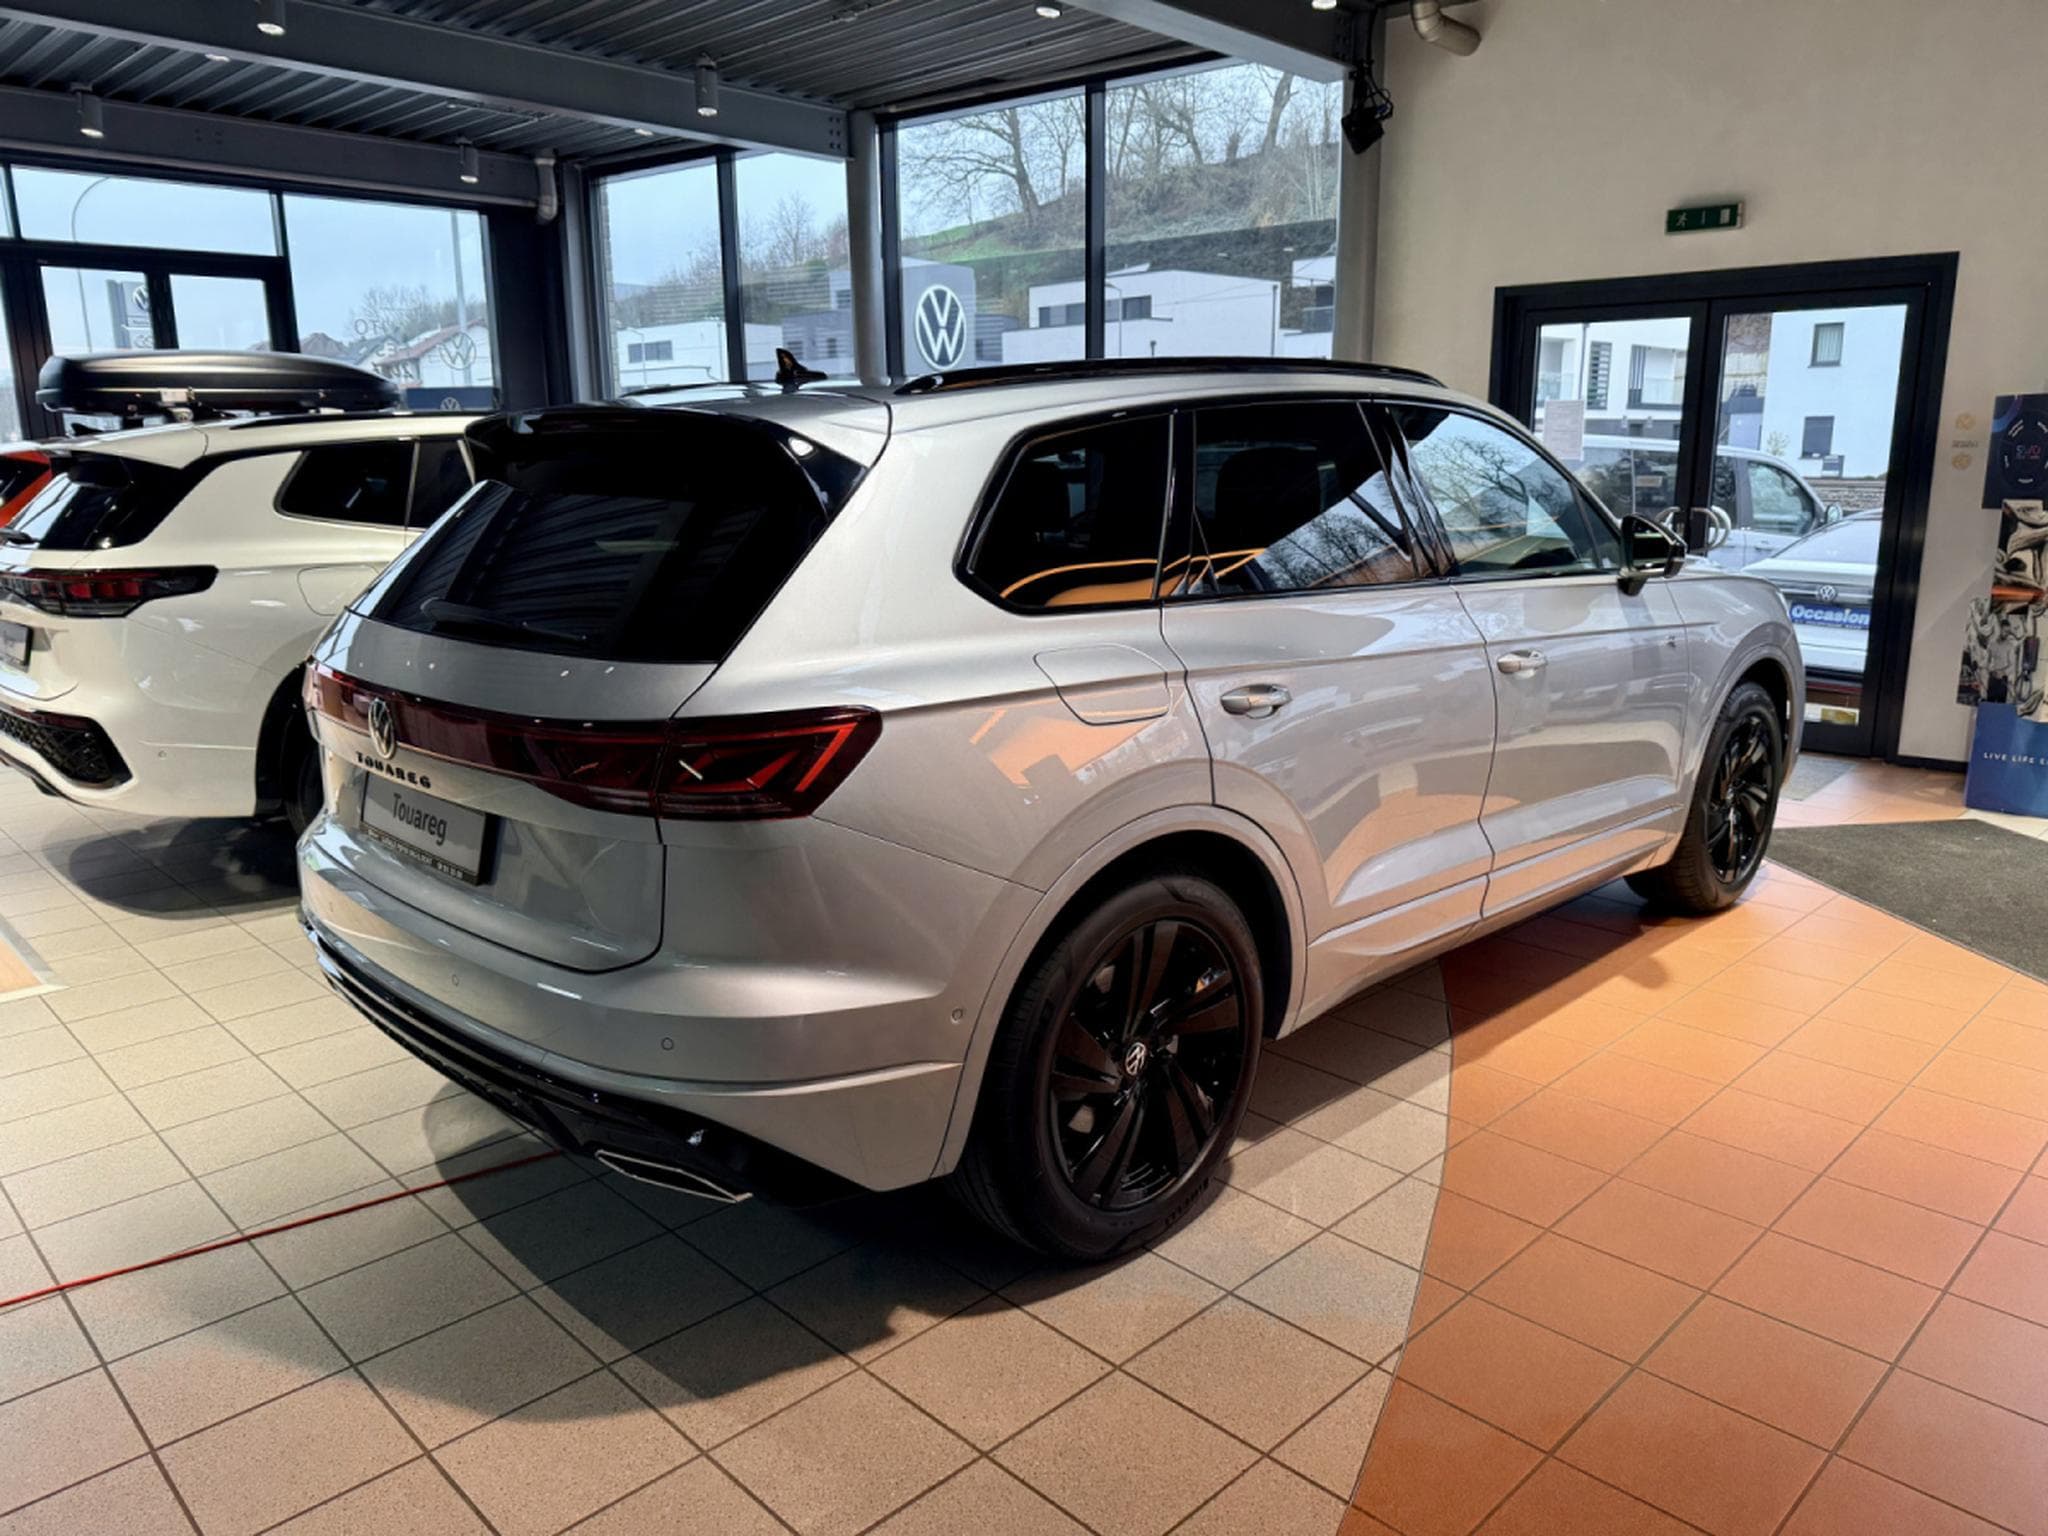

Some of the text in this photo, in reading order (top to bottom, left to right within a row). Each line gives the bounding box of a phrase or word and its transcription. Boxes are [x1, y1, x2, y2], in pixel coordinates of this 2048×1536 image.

[915, 284, 967, 370] VW
[356, 751, 432, 789] TOUAREG
[1984, 752, 2007, 761] LIVE
[393, 792, 448, 846] Touareg
